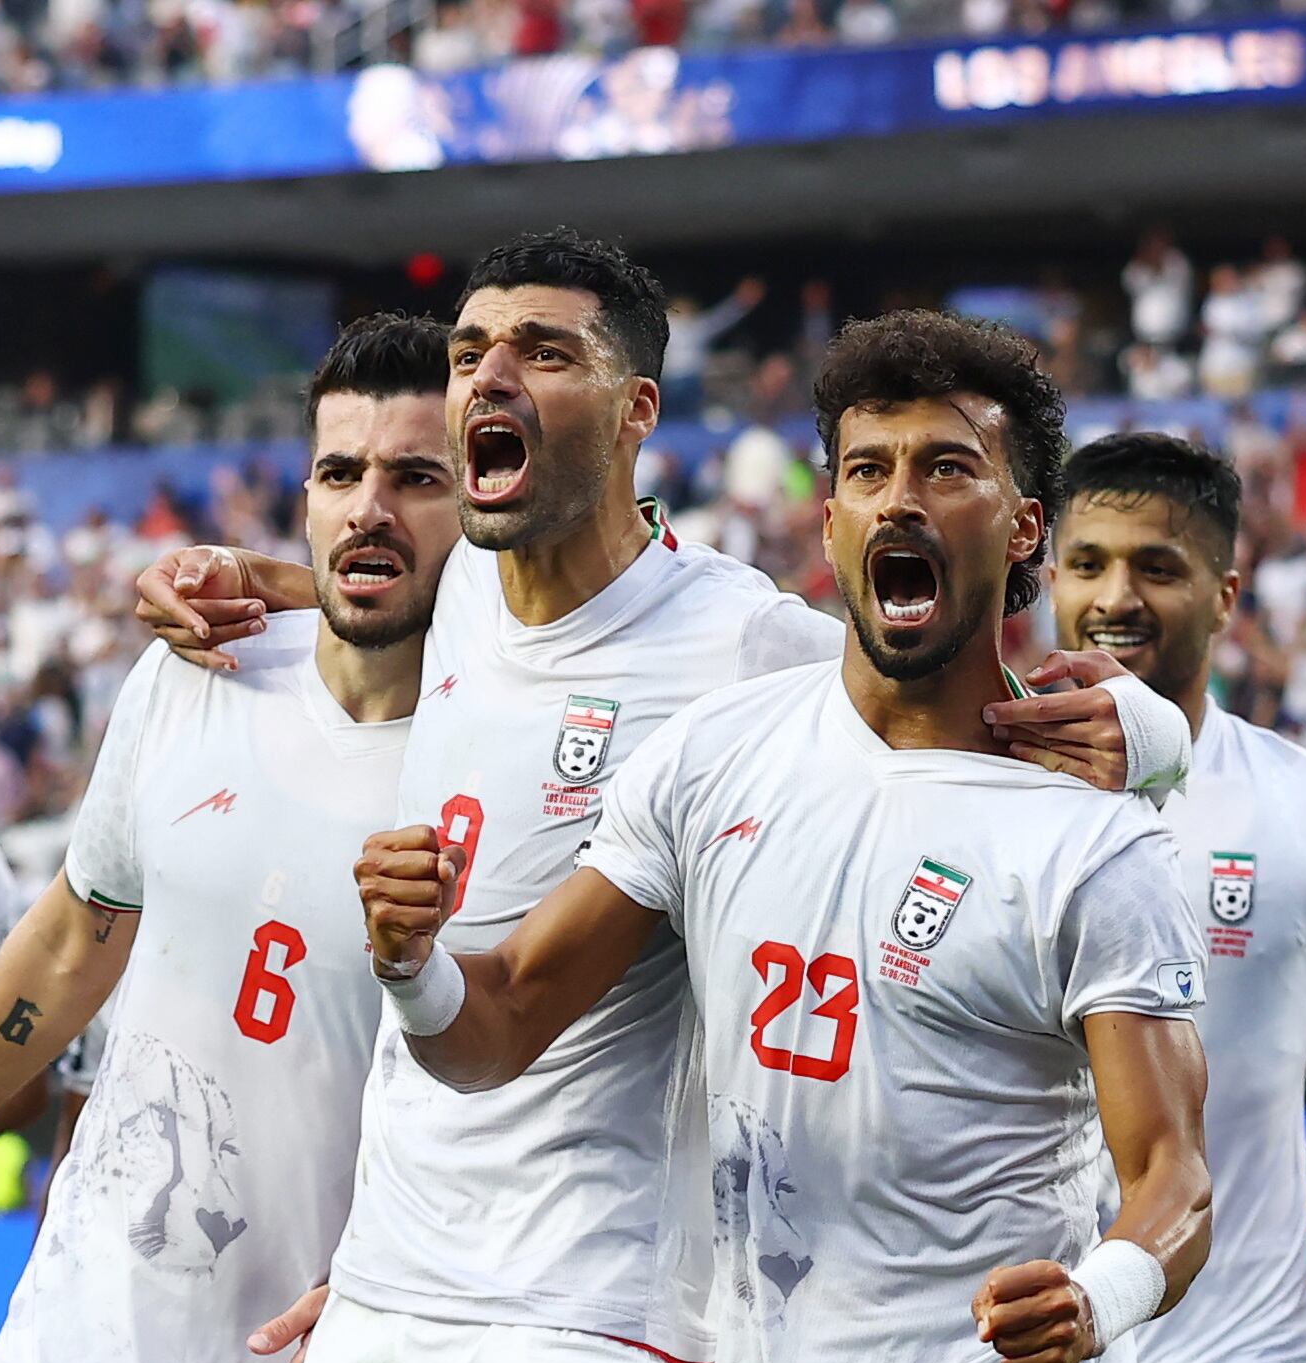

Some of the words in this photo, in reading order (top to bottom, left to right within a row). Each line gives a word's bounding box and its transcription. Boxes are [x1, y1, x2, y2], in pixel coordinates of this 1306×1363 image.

[437, 794, 484, 915] 9
[234, 920, 307, 1045] 6
[751, 941, 859, 1082] 23
[882, 953, 895, 965] LOS
